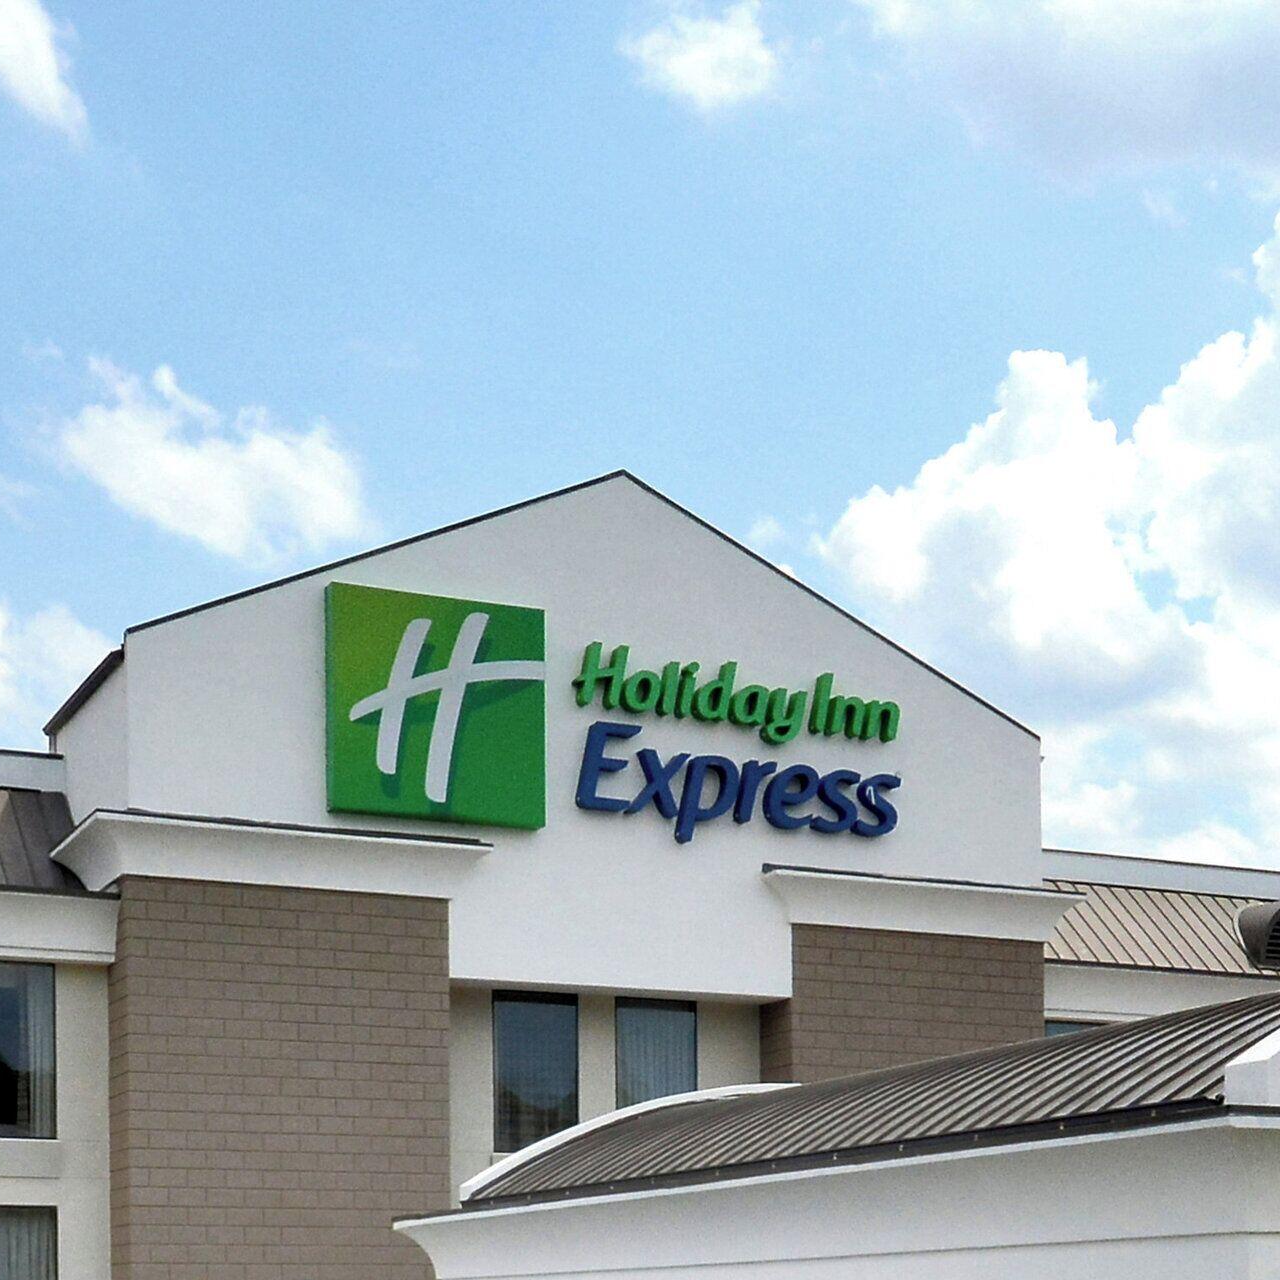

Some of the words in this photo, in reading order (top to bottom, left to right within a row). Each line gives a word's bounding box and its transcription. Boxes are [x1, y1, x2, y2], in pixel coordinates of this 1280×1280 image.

[572, 641, 807, 745] Holiday
[808, 672, 901, 743] Inn
[575, 721, 902, 844] Express
